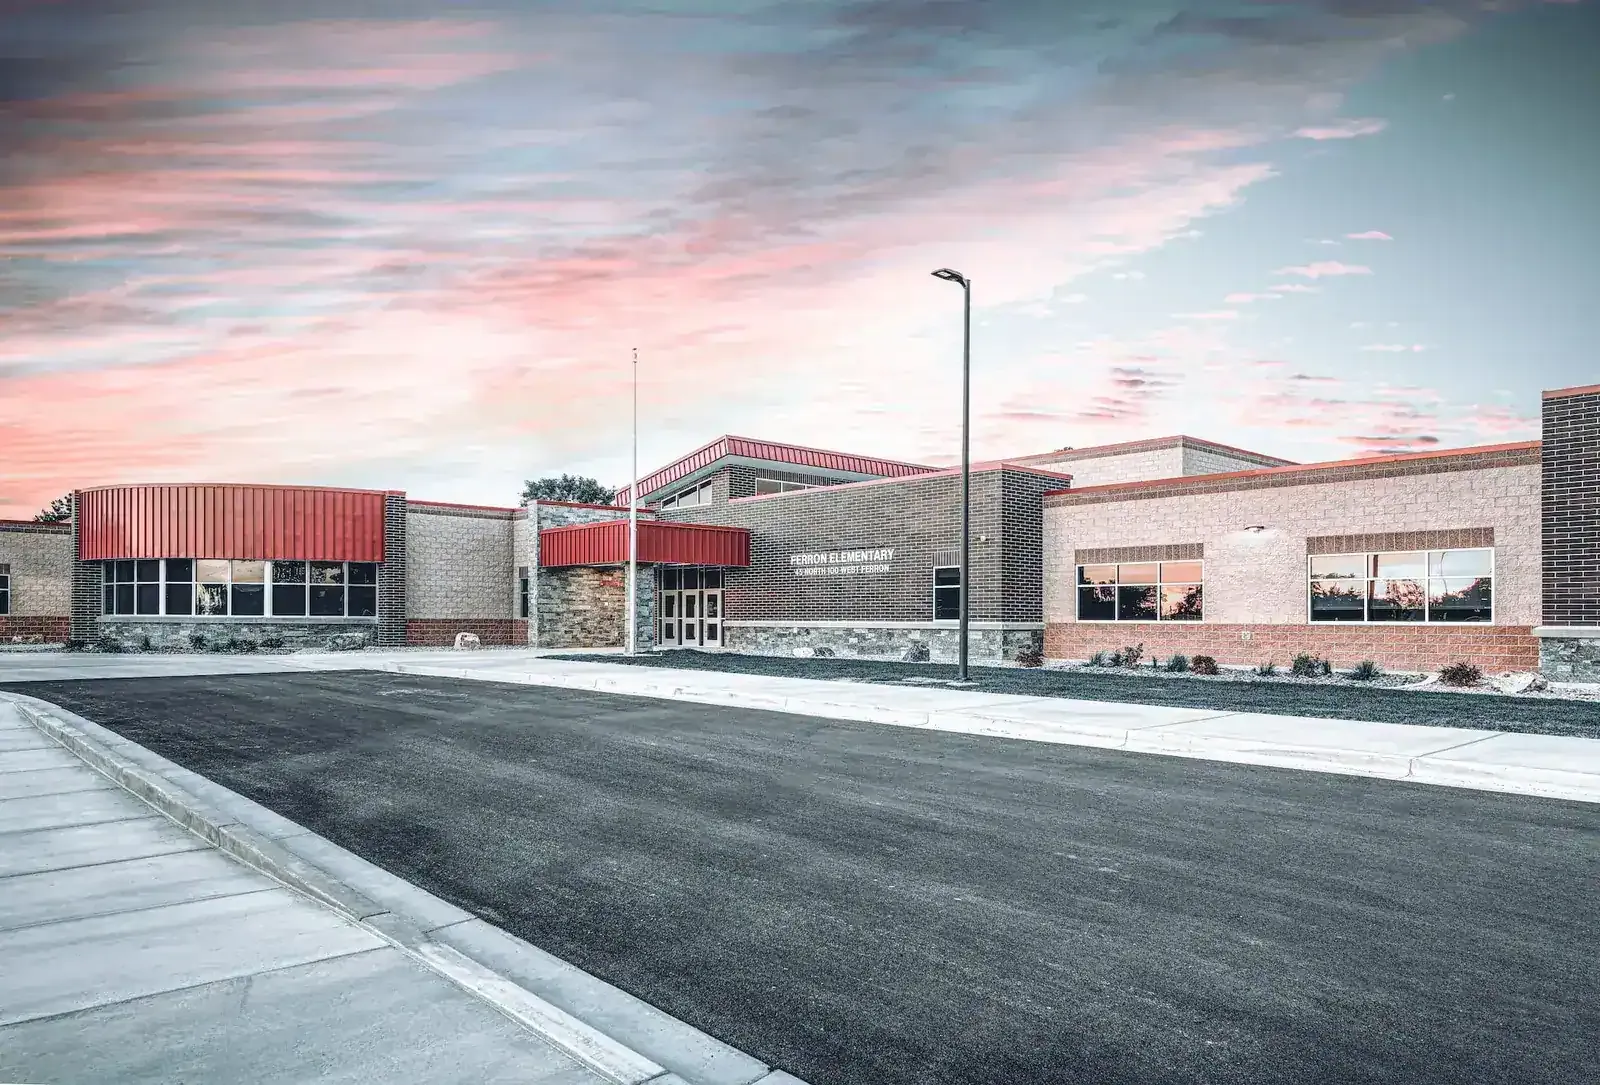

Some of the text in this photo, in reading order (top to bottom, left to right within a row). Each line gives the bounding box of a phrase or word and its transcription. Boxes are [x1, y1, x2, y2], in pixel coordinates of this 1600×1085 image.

[790, 548, 895, 566] FERRON ELEMENTARY
[804, 567, 826, 576] NORTH
[827, 566, 839, 575] 100
[840, 565, 860, 574] WEST
[861, 564, 890, 574] FERRON
